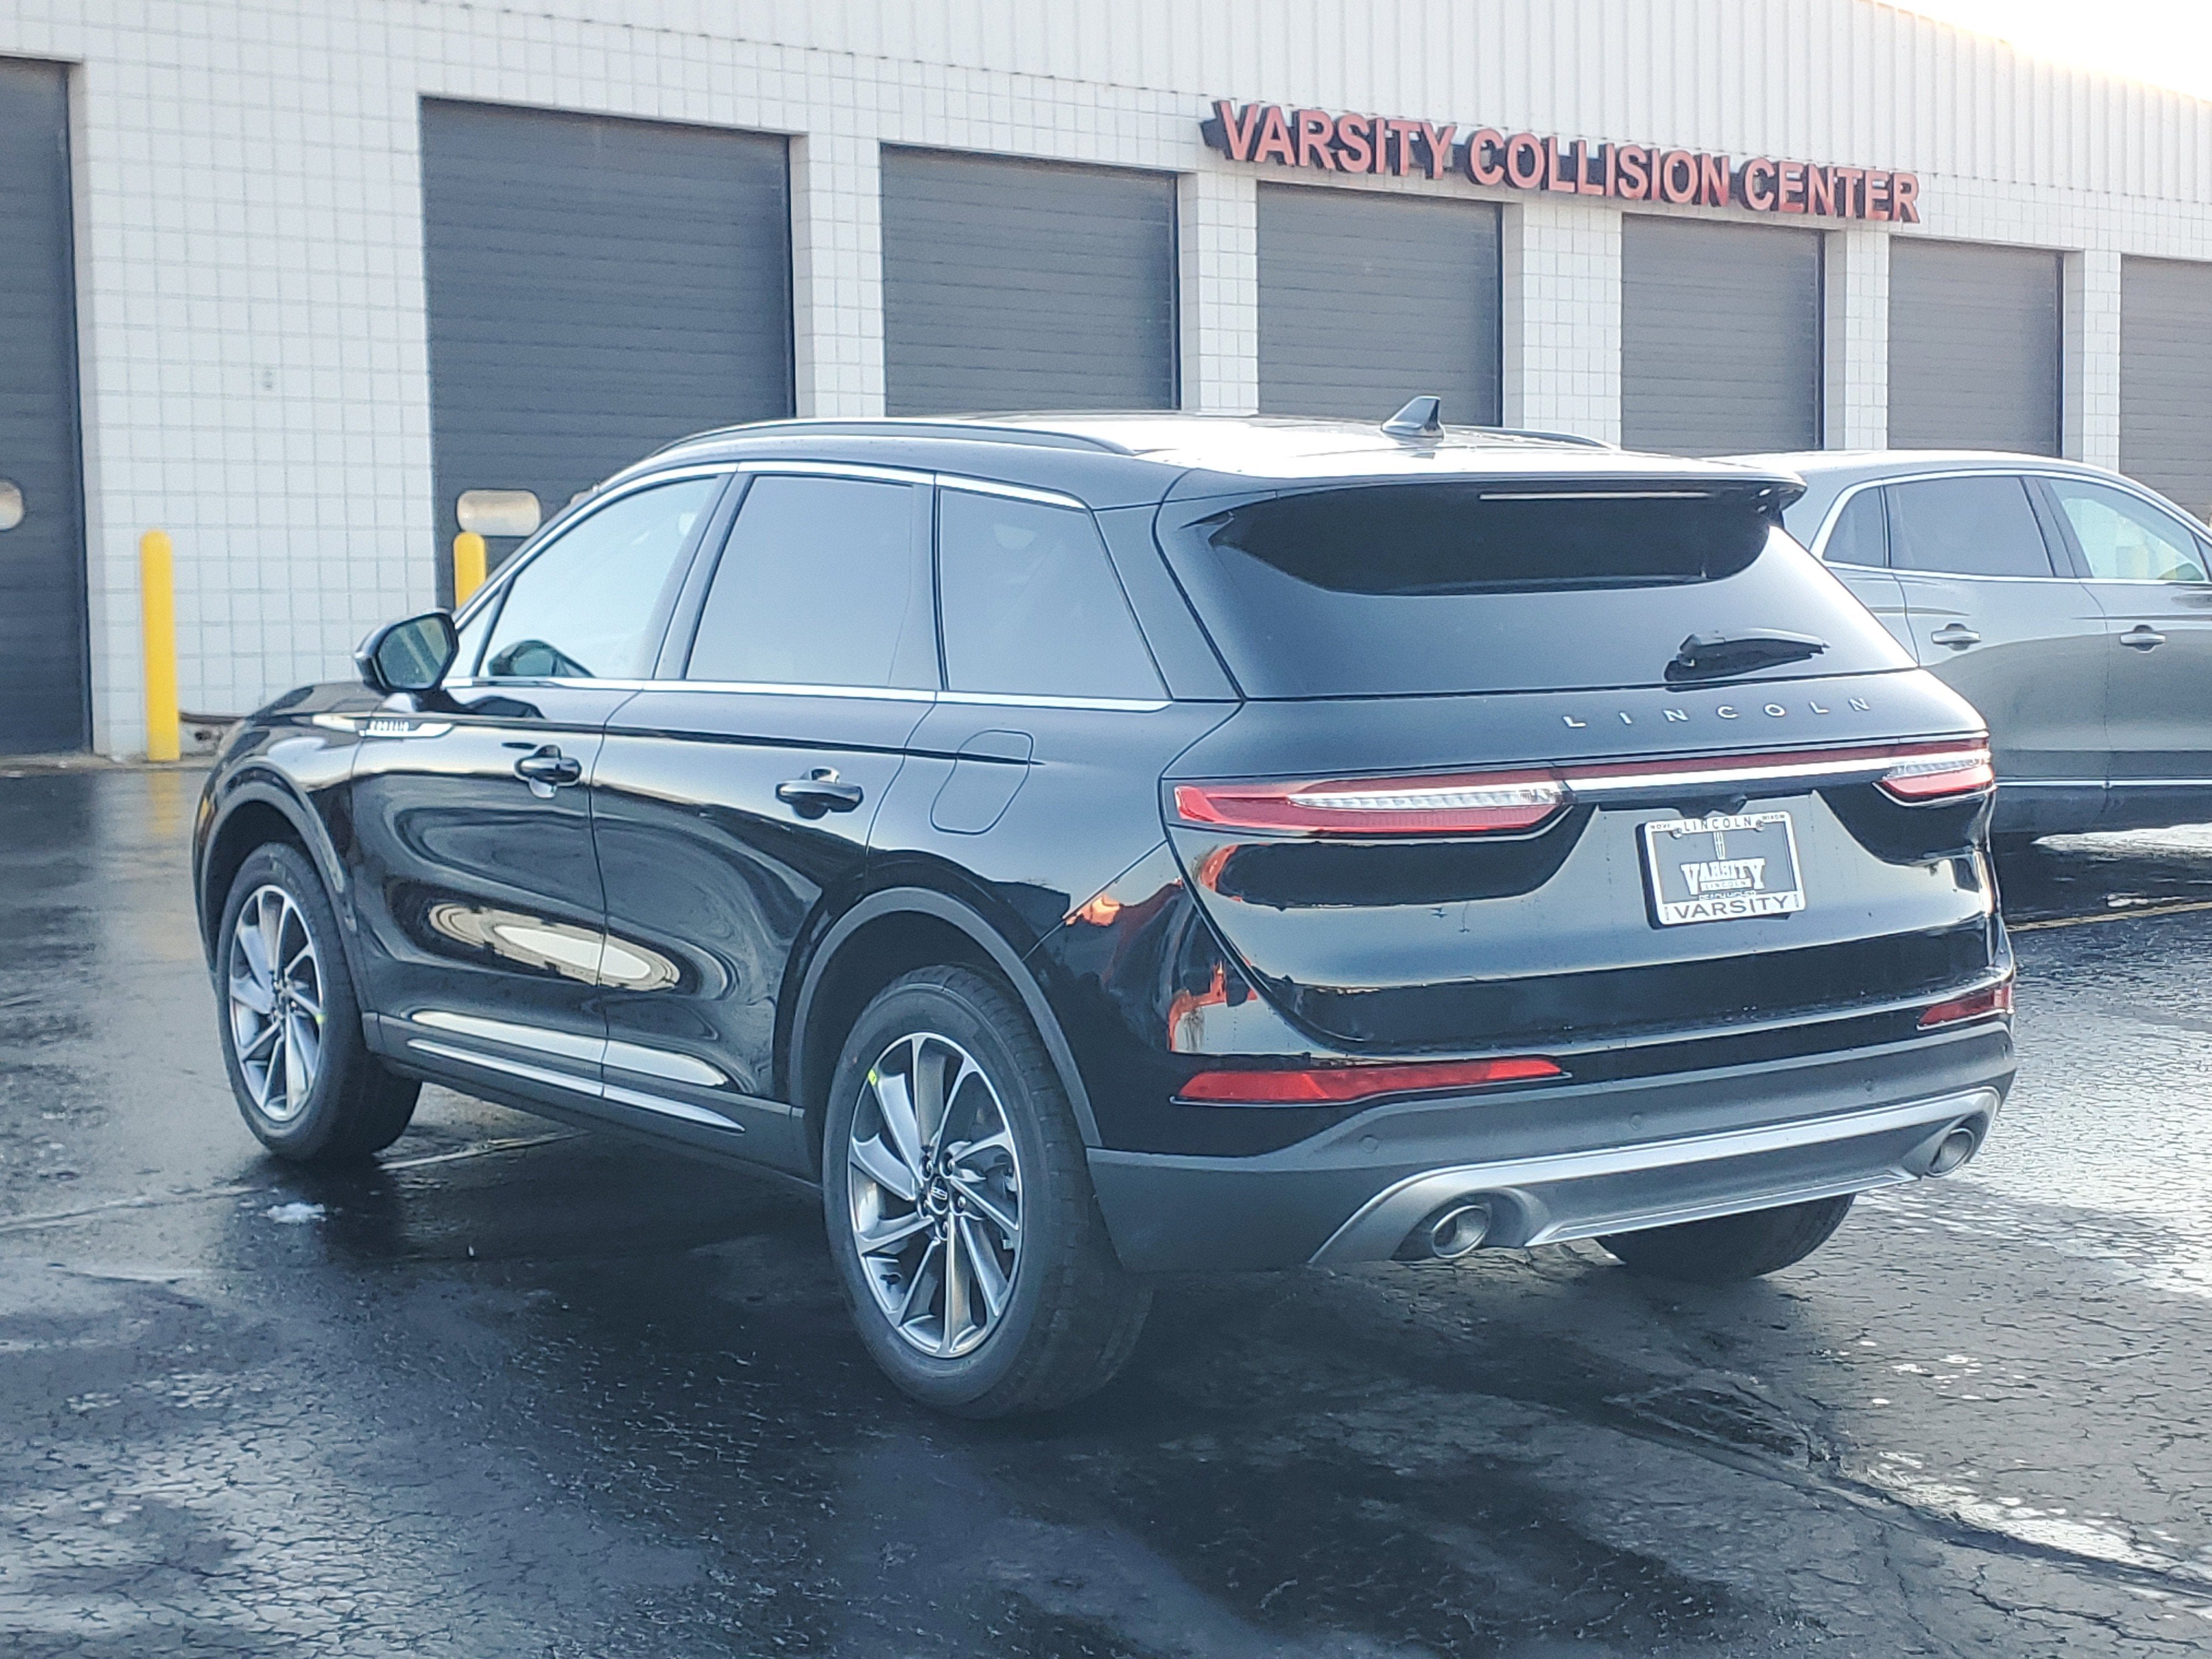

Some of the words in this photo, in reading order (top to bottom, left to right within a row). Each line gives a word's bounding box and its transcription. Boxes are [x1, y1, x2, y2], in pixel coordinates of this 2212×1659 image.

[1214, 100, 1457, 179] VARSITY
[1469, 128, 1730, 207] COLLISION
[1742, 157, 1920, 223] CENTER
[1562, 697, 1870, 728] LINCOLN
[1684, 817, 1751, 832] LINCOLN
[1680, 857, 1765, 895] VARSITY
[1674, 895, 1788, 919] VARSITY
